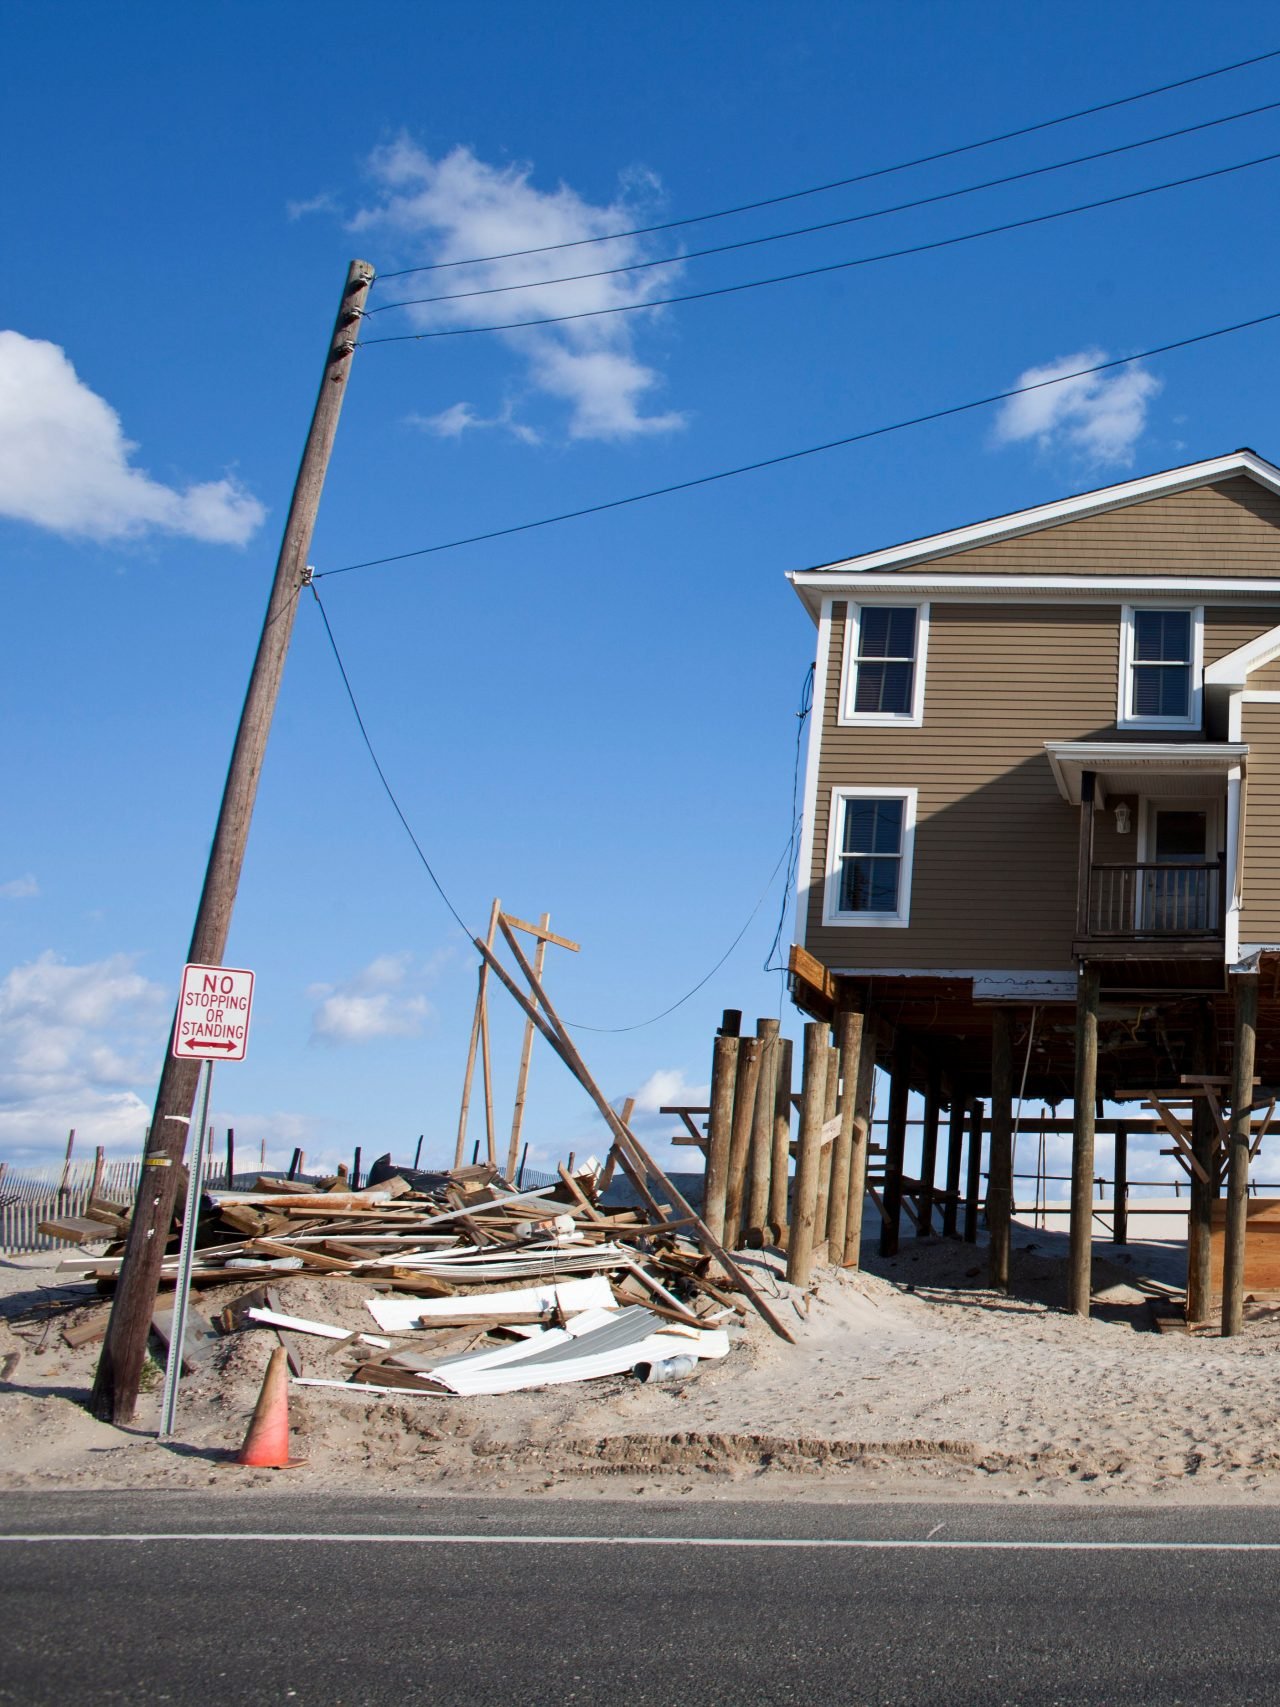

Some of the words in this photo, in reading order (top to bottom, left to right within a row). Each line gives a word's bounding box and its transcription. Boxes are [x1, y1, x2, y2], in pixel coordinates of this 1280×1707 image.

[203, 974, 234, 994] NO
[185, 992, 247, 1010] STOPPING
[206, 1008, 224, 1023] OR
[181, 1021, 244, 1040] STANDING
